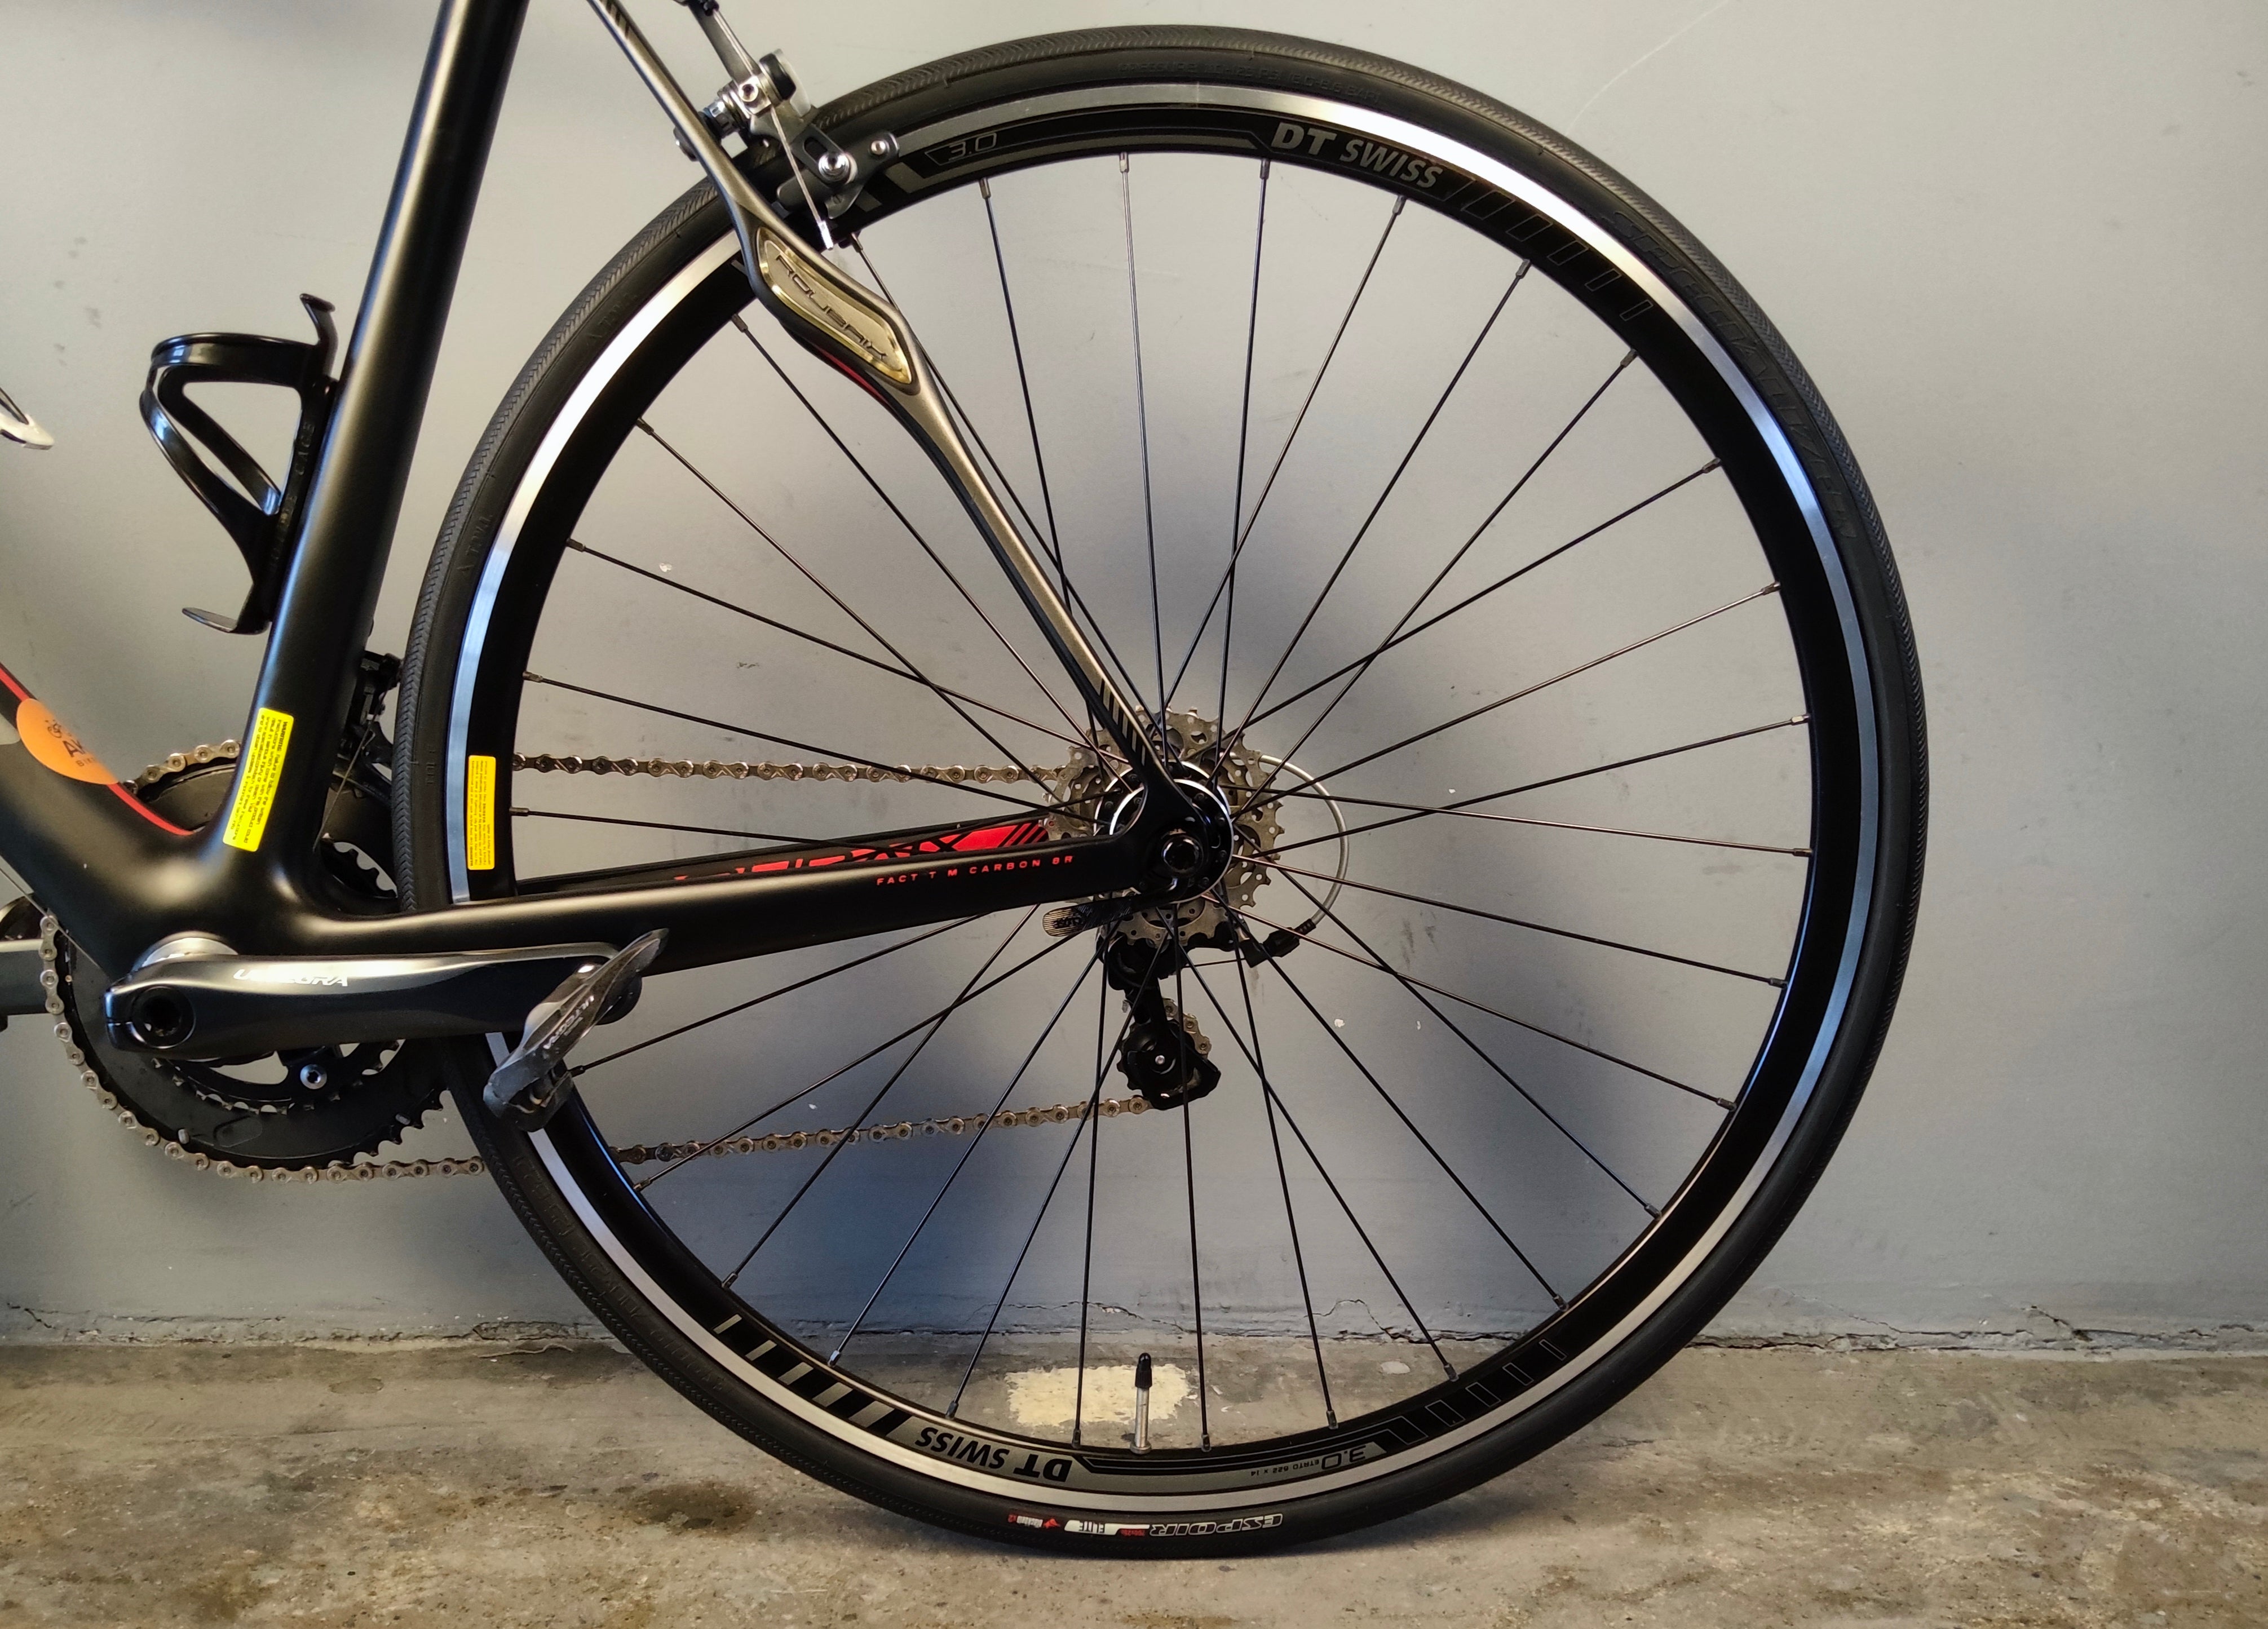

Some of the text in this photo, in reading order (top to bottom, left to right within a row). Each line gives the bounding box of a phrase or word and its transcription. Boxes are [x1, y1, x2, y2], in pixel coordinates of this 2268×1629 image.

[947, 132, 998, 161] 3.0
[1271, 122, 1444, 188] DT SWISS
[775, 254, 888, 361] ROUBAIX
[877, 874, 918, 886] FACT
[969, 860, 1041, 874] CARBON
[543, 995, 595, 1050] ULTEGRA
[914, 1427, 1072, 1482] DT SWISS
[1321, 1445, 1367, 1470] 3.0
[1272, 1466, 1289, 1474] 622
[1079, 1521, 1106, 1534] ELITE
[1150, 1513, 1283, 1536] ESPOIR
